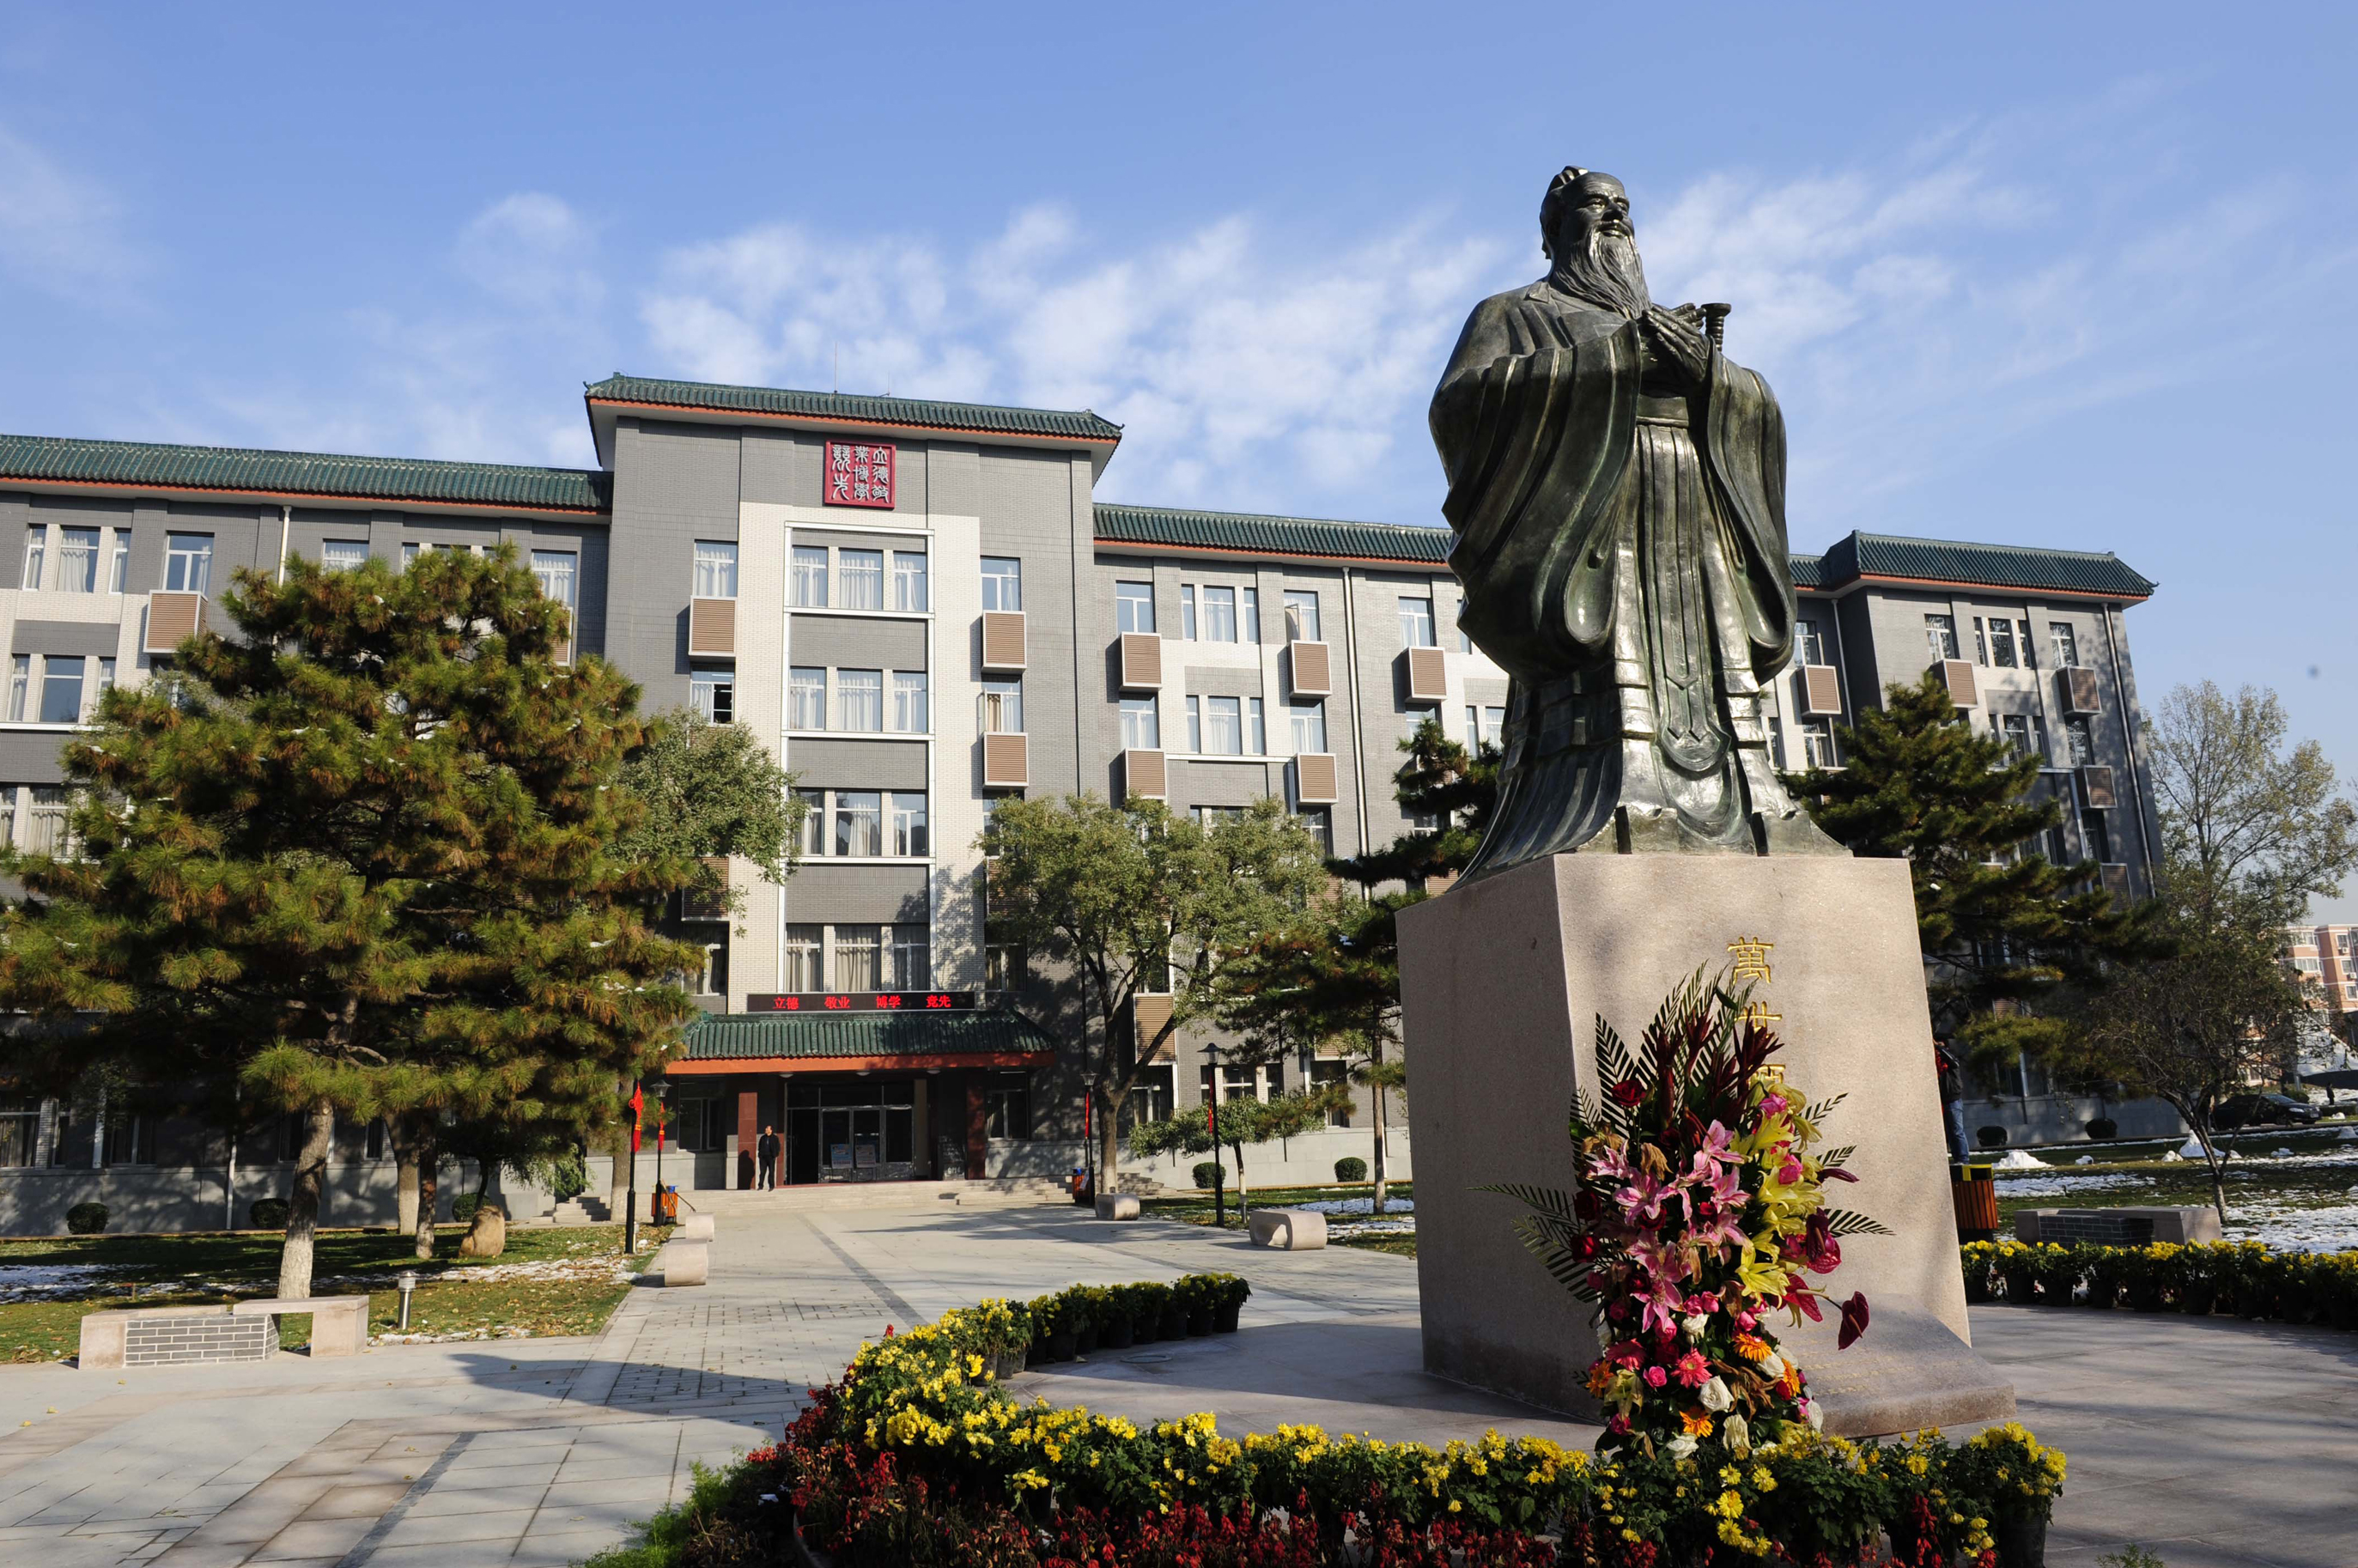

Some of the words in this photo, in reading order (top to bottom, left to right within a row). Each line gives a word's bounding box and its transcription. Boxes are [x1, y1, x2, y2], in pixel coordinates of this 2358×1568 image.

[773, 996, 799, 1010] 立德
[823, 996, 850, 1009] 敬业
[875, 994, 902, 1009] 博学
[925, 994, 951, 1008] 竞先
